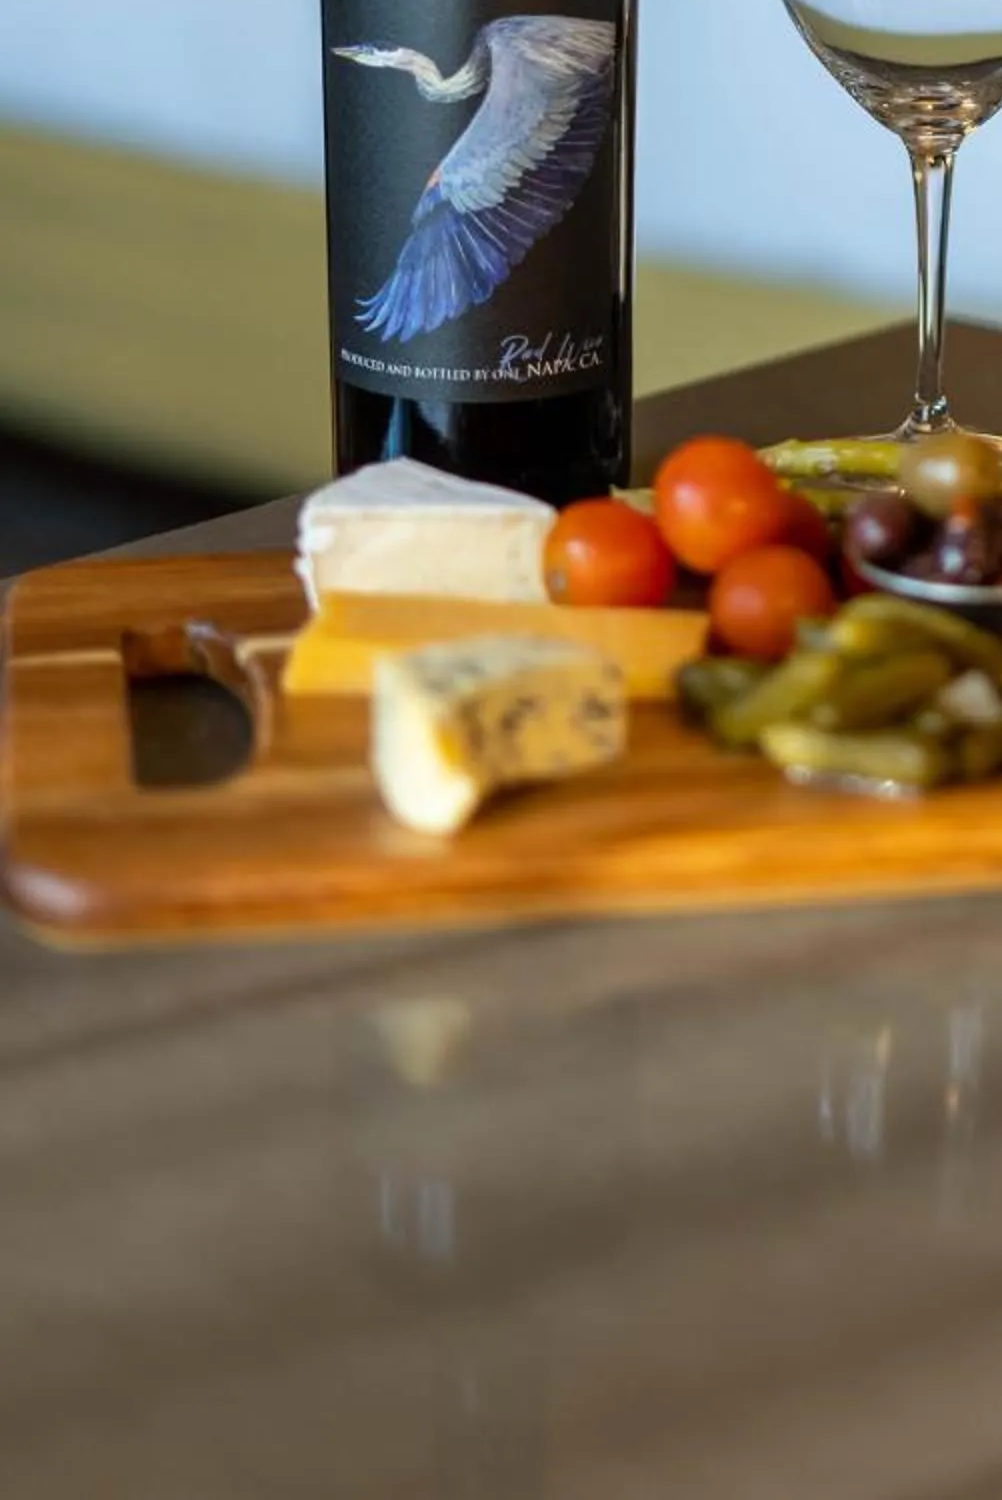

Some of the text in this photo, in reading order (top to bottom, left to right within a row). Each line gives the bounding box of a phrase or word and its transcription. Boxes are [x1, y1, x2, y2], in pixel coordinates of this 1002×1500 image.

[386, 362, 412, 377] AND
[414, 367, 471, 382] BOTTLED
[474, 368, 488, 382] BY
